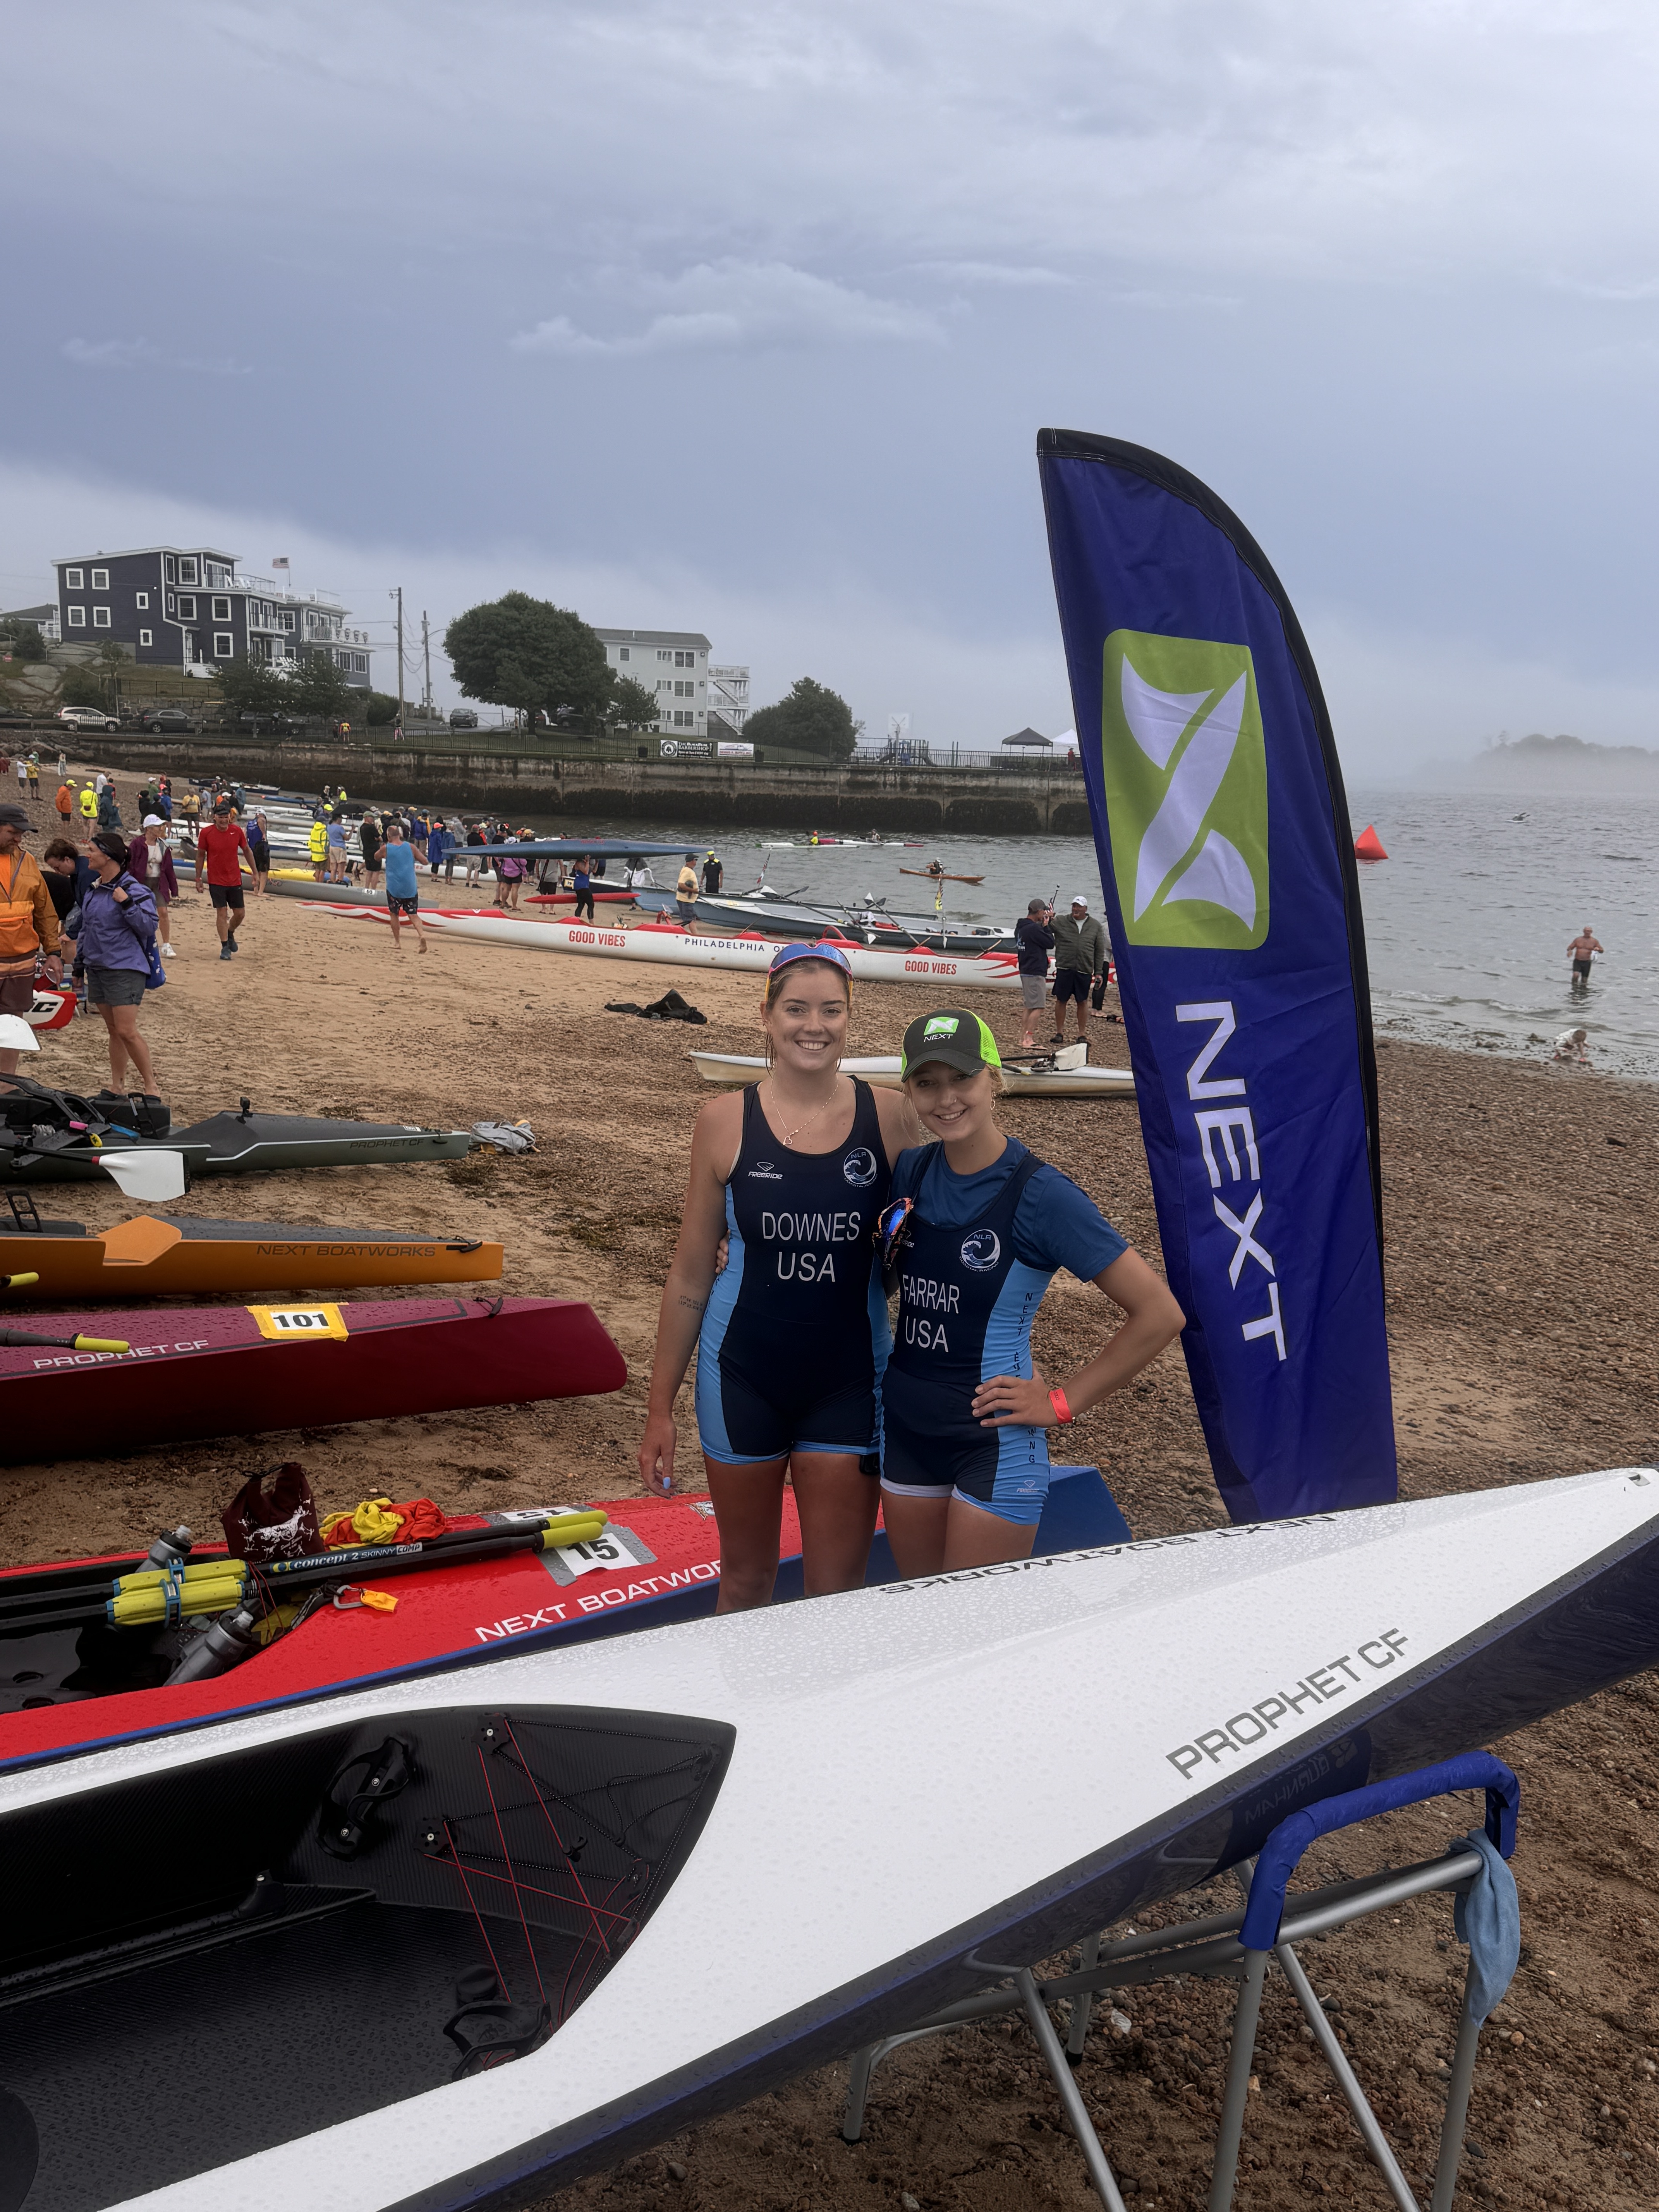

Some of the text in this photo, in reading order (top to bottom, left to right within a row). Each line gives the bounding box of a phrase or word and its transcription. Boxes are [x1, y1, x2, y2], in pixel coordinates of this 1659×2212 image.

[569, 930, 626, 947] GOOD VIBES
[685, 938, 764, 951] PHILADELPHIA
[905, 960, 957, 975] GOOD VIBES
[924, 1034, 953, 1042] NEXT
[350, 1139, 408, 1149] PROPHET
[1176, 1000, 1287, 1361] NEXT
[762, 1211, 860, 1241] DOWNES
[257, 1245, 435, 1257] NEXT BOATWORKS
[778, 1252, 835, 1282] USA
[903, 1274, 960, 1314] FARRAR
[273, 1314, 329, 1330] 101
[906, 1316, 949, 1353] USA
[33, 1340, 209, 1369] PROPHET CF
[294, 1554, 348, 1568] concept
[361, 1547, 396, 1559] SKINNY
[398, 1544, 420, 1554] COMP
[567, 1539, 619, 1560] 15
[879, 1515, 1337, 1594] NEXT BOATWORKS
[475, 1603, 566, 1642] NEXT
[1166, 1627, 1409, 1780] PROPHET CF
